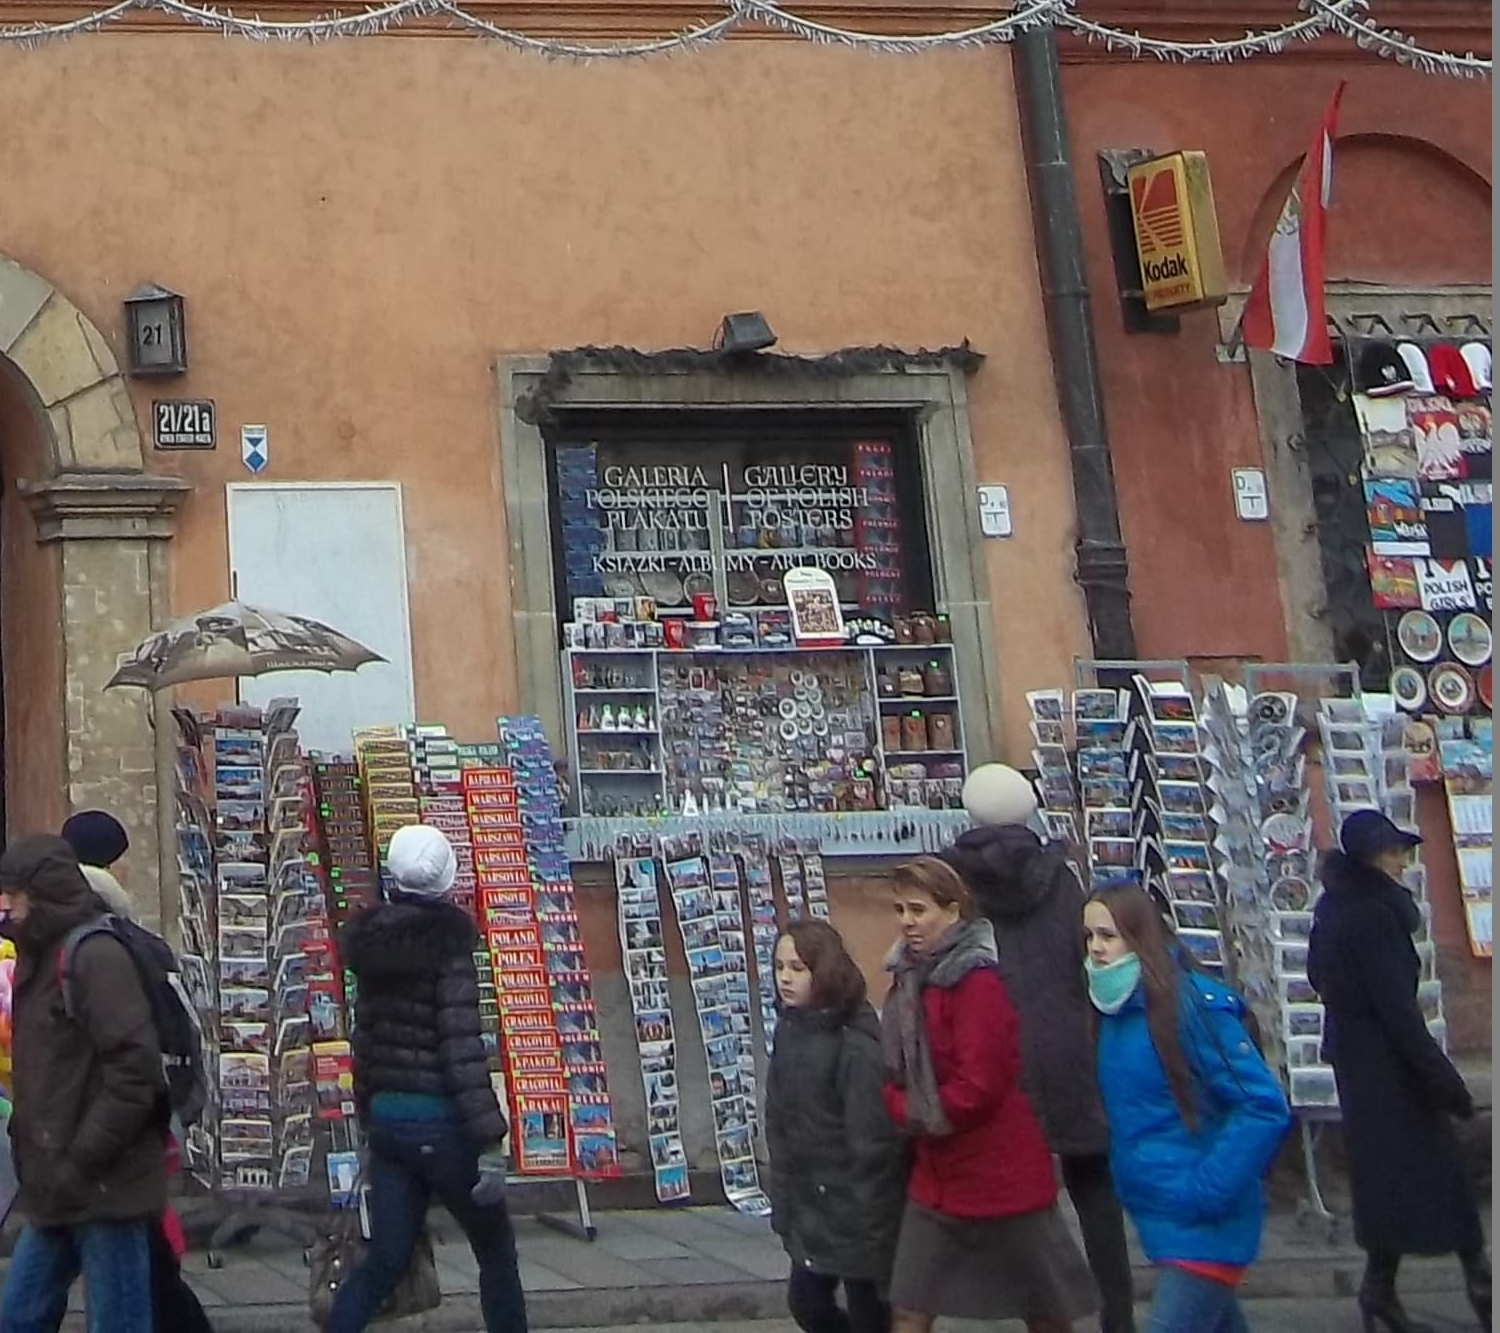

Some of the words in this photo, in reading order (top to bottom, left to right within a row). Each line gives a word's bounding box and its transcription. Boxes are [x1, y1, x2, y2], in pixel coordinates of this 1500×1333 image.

[1143, 252, 1189, 284] Kodak
[143, 324, 162, 346] 21
[604, 465, 709, 487] GALERIA
[744, 464, 848, 487] GALLERY
[585, 487, 710, 510] POLSKIEGO
[747, 487, 779, 509] OF
[785, 486, 869, 509] POLISH
[606, 508, 711, 531] PLAKATU
[750, 508, 853, 530] POSTERS
[814, 551, 877, 571] BOOKS
[1424, 579, 1469, 594] POLISH
[491, 930, 536, 946] POLAND
[498, 952, 535, 967] POLEN
[498, 972, 541, 987] POLONIA
[501, 993, 545, 1006] CRACOVIA
